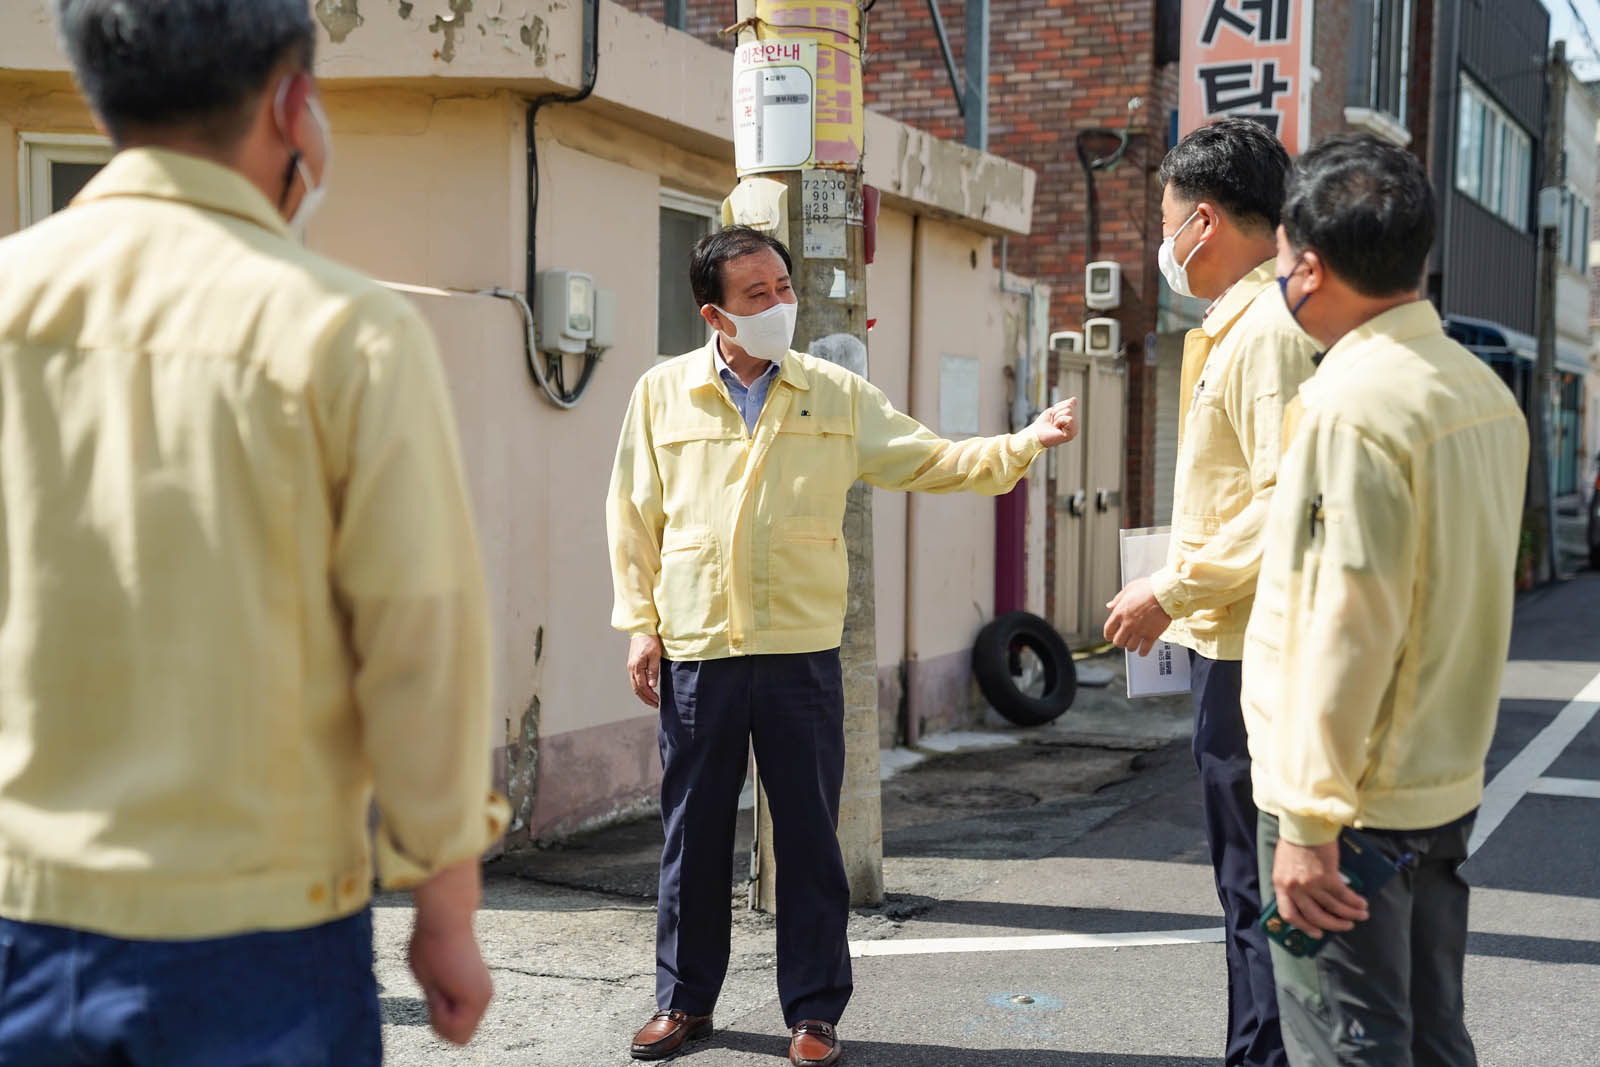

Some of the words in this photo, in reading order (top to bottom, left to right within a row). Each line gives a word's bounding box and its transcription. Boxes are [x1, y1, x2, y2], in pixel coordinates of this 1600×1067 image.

[741, 43, 800, 64] 이전안내
[812, 191, 836, 201] 901
[813, 203, 829, 213] 28
